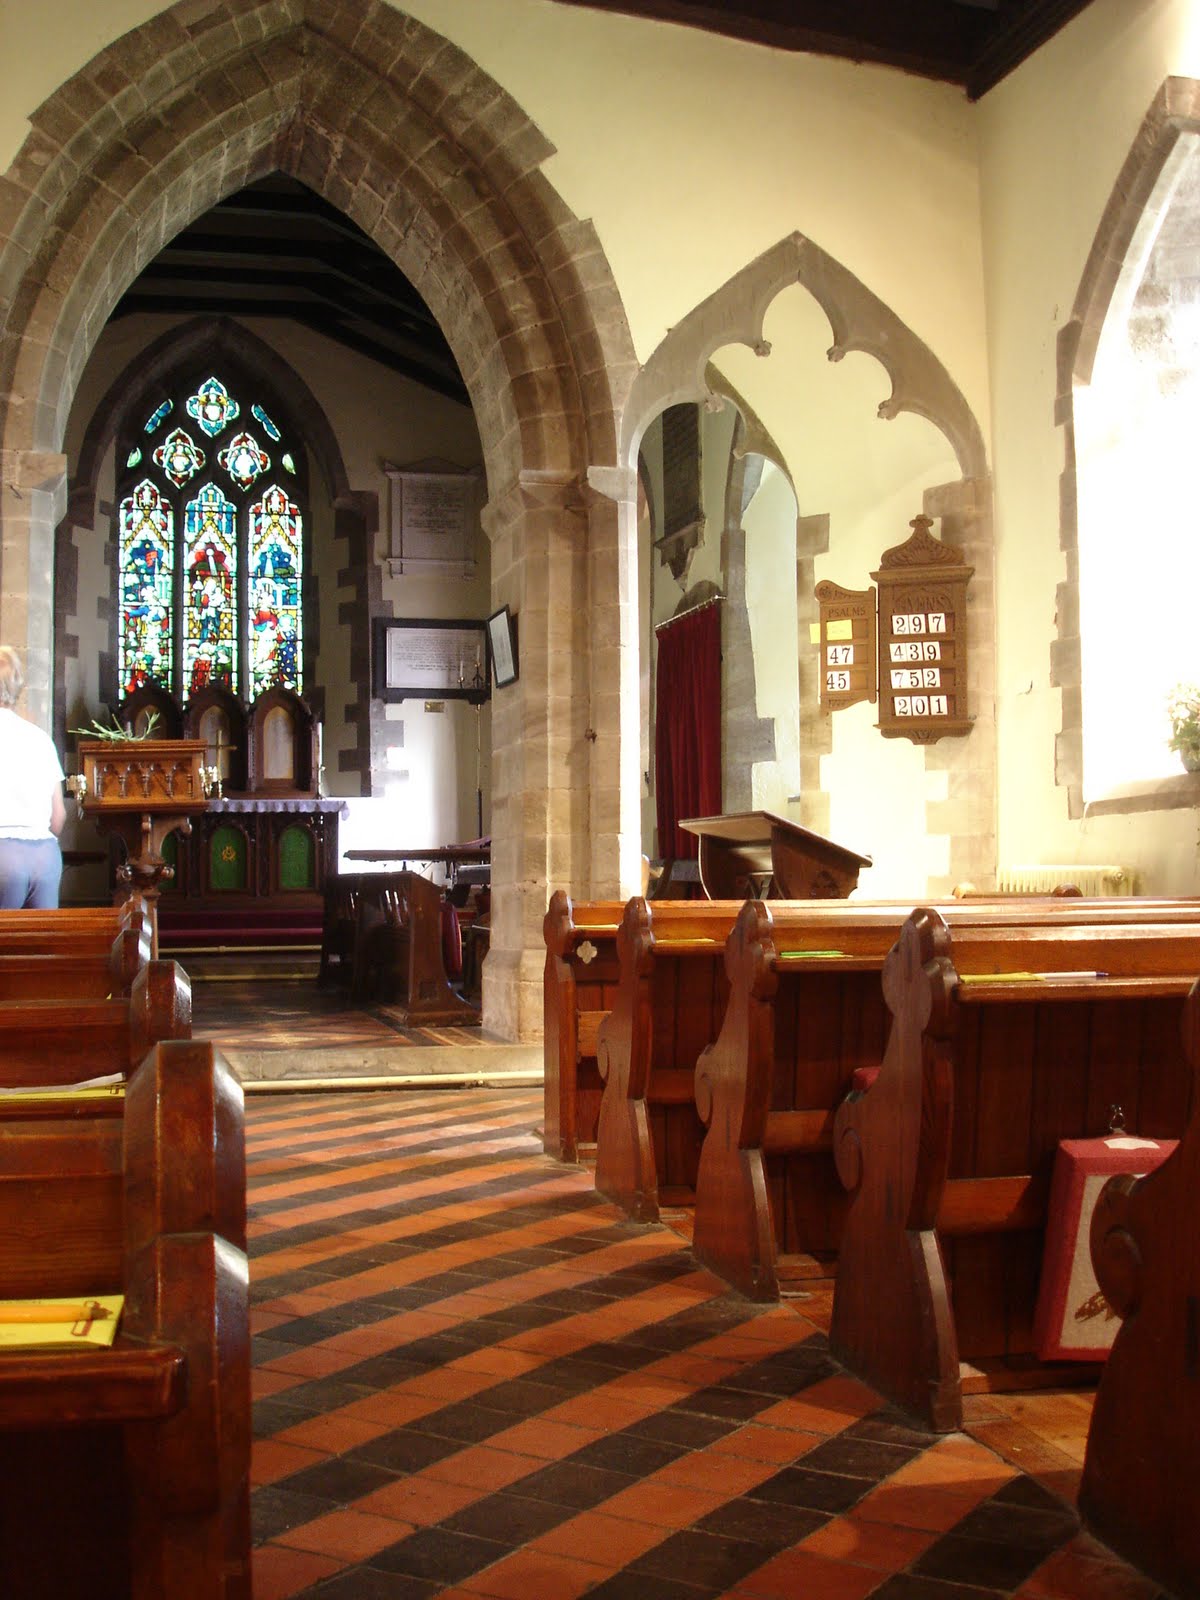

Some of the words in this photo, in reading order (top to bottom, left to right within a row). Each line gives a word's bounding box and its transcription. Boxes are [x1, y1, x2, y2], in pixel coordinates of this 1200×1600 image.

[828, 606, 866, 618] PSALMS
[896, 615, 942, 633] 297
[830, 647, 850, 664] 47
[894, 643, 937, 661] 439
[826, 673, 847, 689] 45
[894, 670, 937, 688] 752
[898, 698, 944, 714] 201
